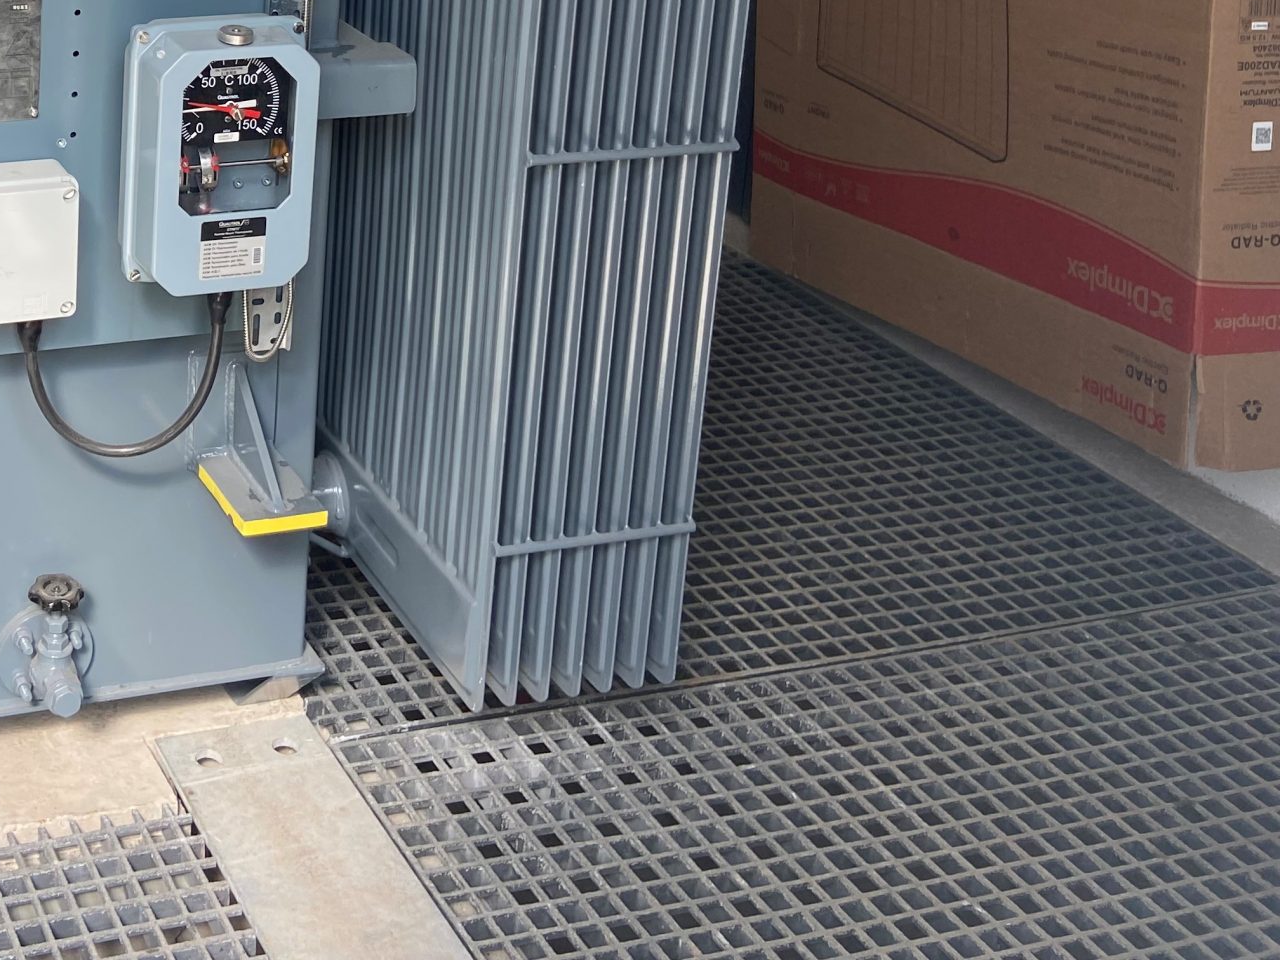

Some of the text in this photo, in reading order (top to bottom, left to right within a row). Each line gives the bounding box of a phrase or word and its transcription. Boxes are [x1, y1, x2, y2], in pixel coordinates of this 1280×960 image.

[201, 76, 216, 88] 50
[237, 73, 258, 86] 100
[1239, 88, 1280, 98] UANTUM
[196, 118, 257, 134] 0 150
[1230, 233, 1280, 250] Q-RAD
[1067, 257, 1149, 314] Dimplex
[1213, 313, 1277, 333] Dimplex
[1081, 375, 1147, 426] Dimplex
